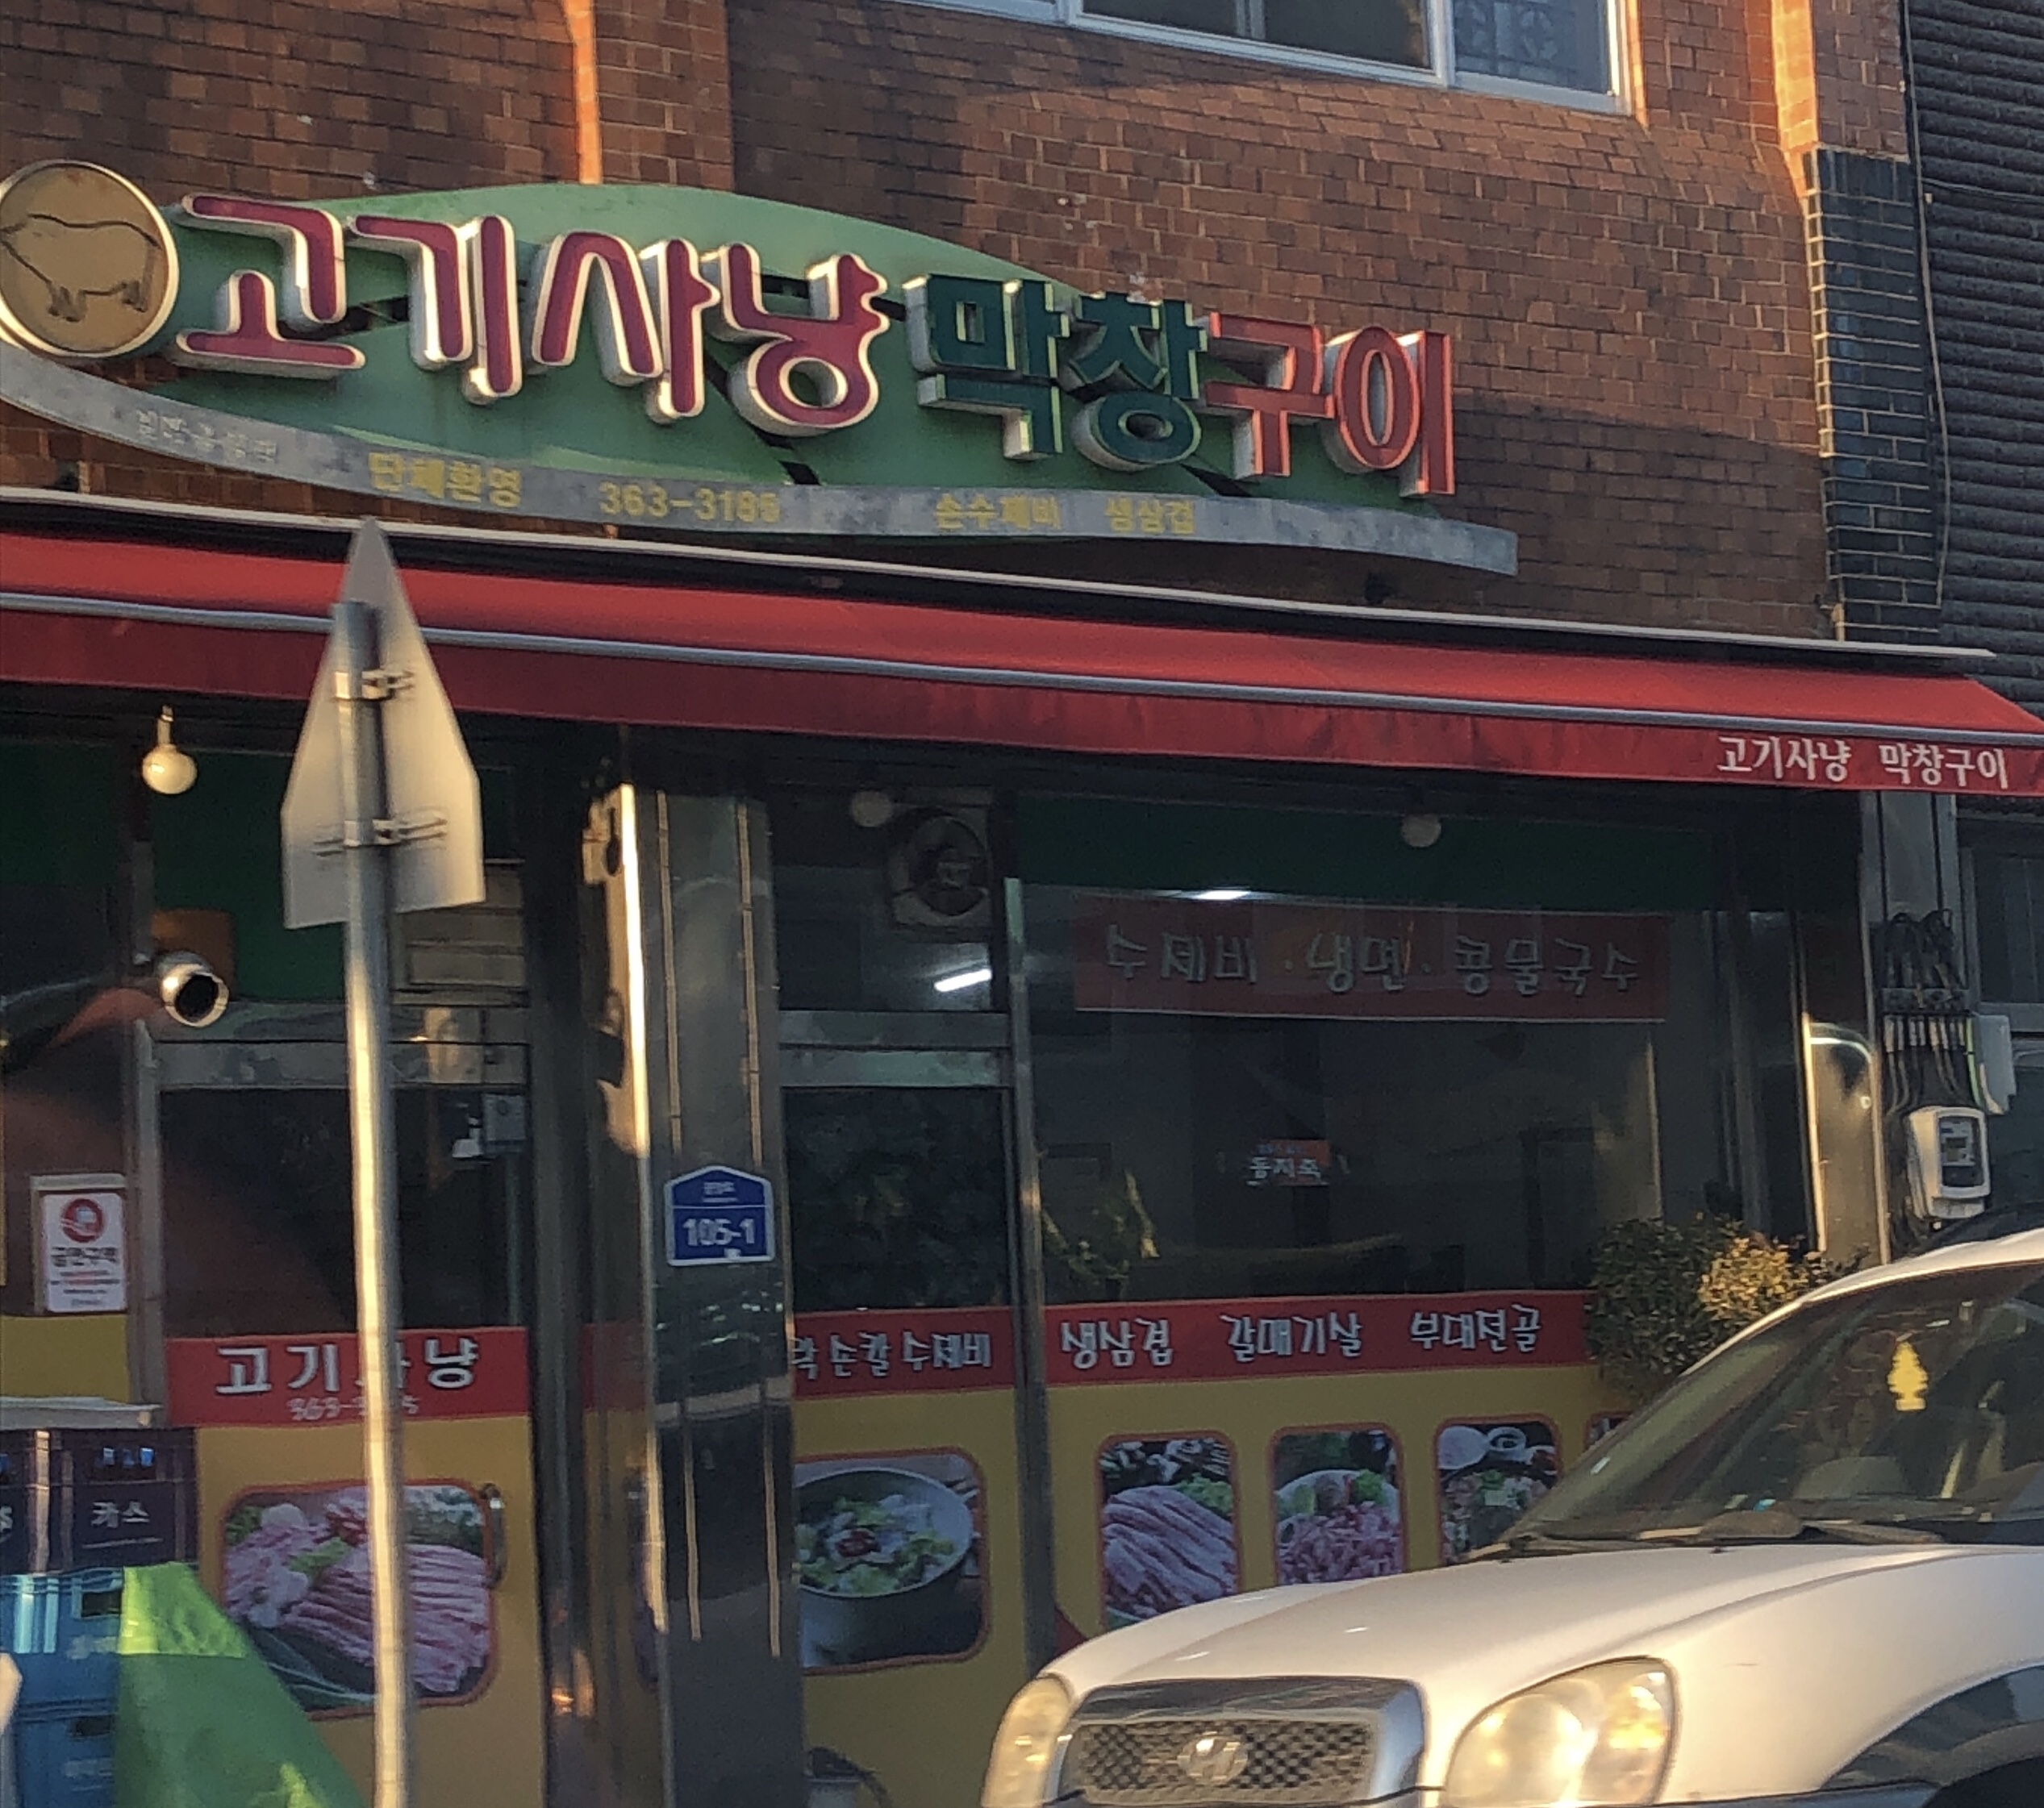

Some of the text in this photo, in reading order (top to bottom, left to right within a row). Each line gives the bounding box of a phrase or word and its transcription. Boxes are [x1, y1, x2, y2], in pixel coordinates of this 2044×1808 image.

[177, 193, 889, 436] 고기사냥
[1717, 735, 2009, 789] 고기사냥 막창구이
[1106, 924, 1257, 983] 수제비
[903, 1331, 991, 1371] 수제비
[1061, 1303, 1541, 1369] 생삼겹 갈매기살 부대전골
[215, 1337, 480, 1395] 고기냥
[287, 1394, 420, 1421] 363-35
[90, 1501, 151, 1529] 카스
